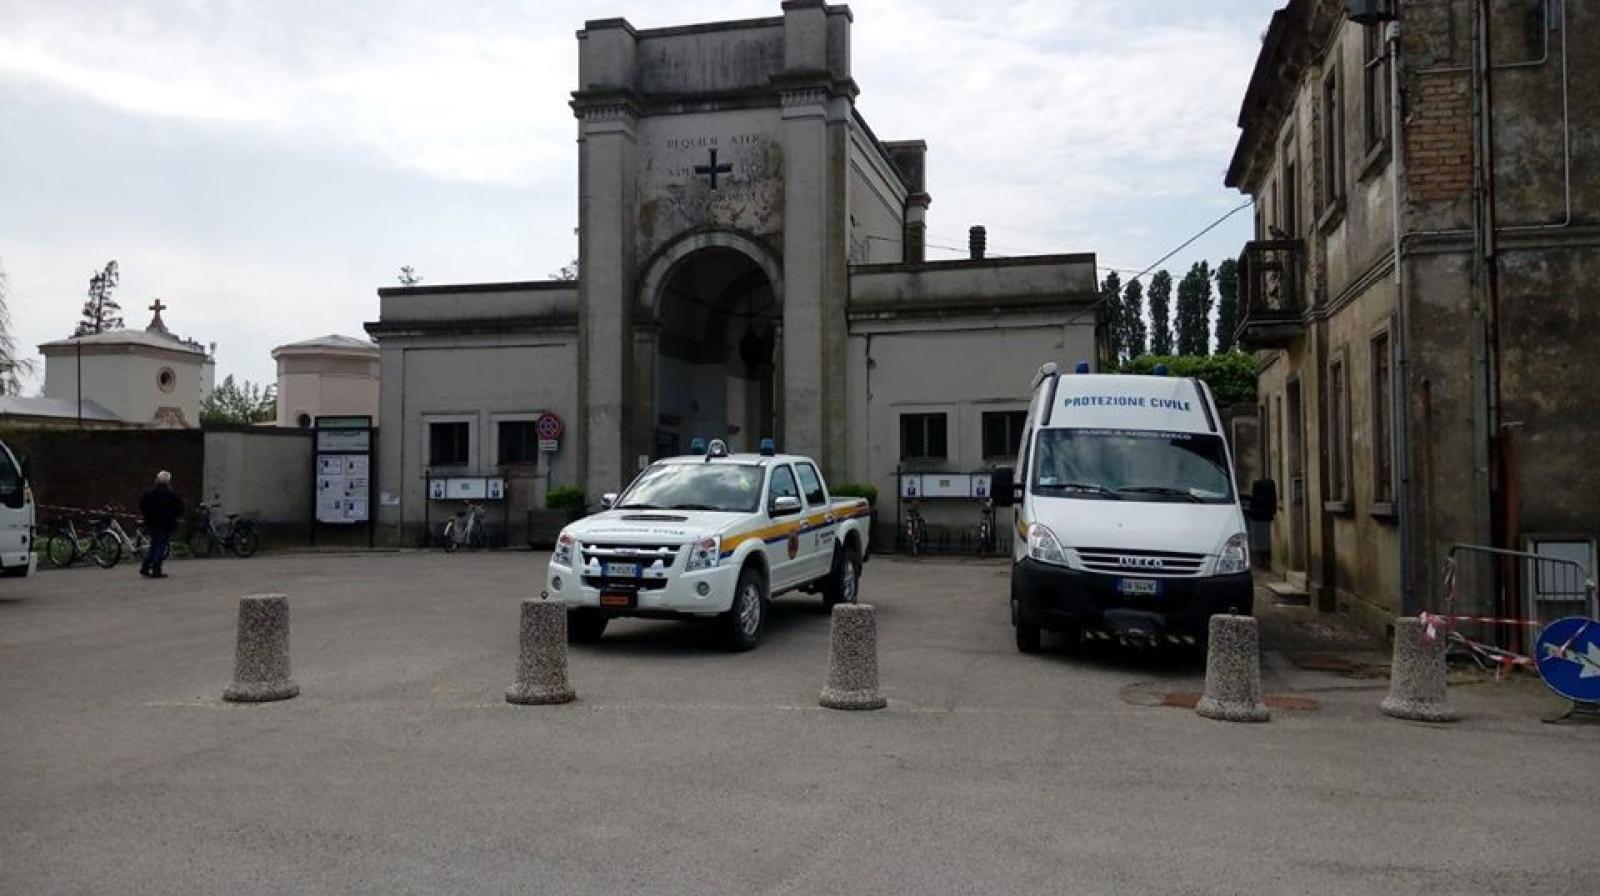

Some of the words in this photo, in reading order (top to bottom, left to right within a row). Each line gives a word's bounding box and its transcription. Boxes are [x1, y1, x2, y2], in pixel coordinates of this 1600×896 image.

[1064, 395, 1145, 407] PROTEZIONE
[1149, 398, 1191, 411] CIVILE
[1119, 555, 1163, 569] IVECO
